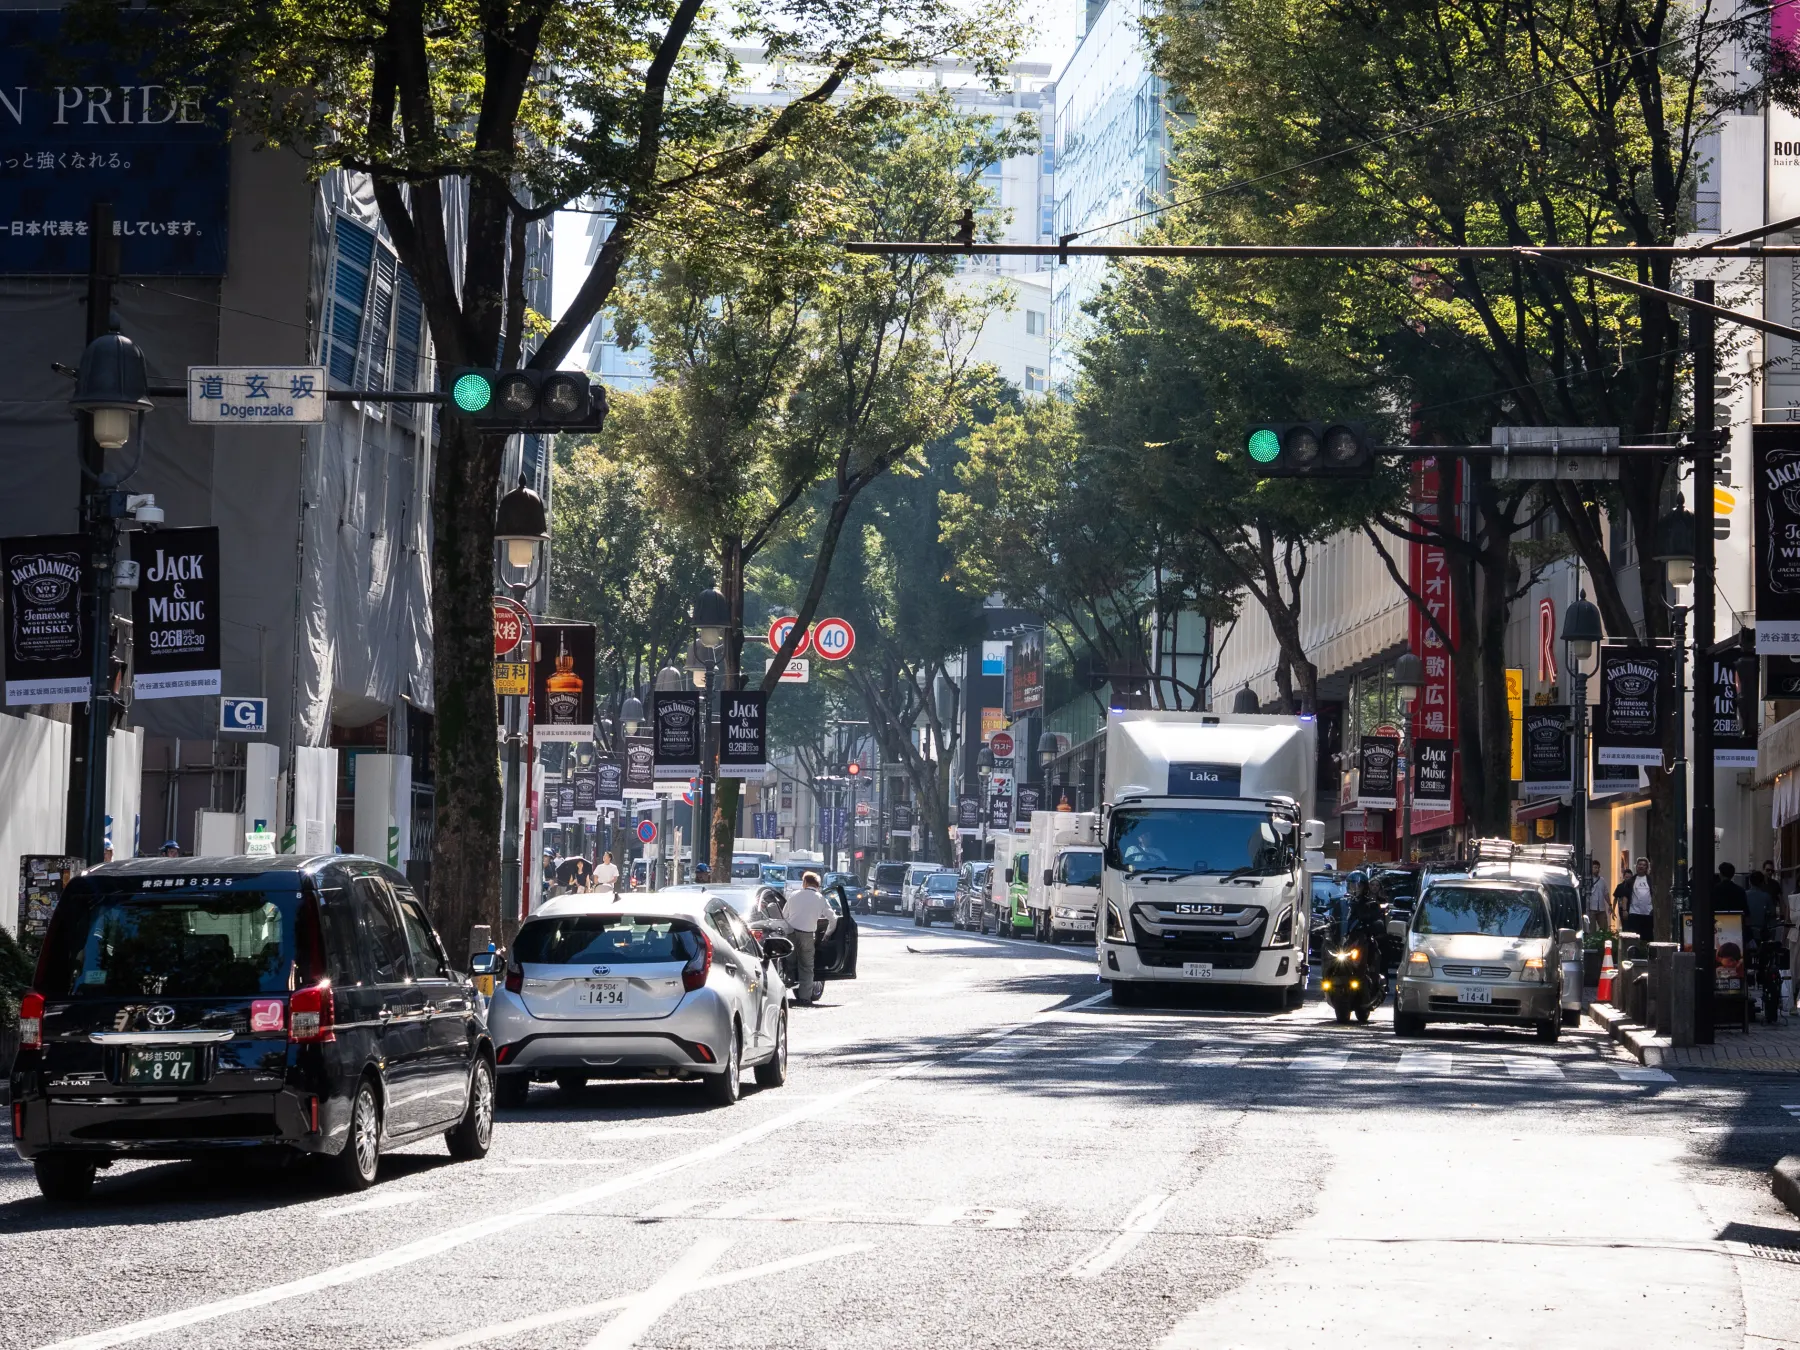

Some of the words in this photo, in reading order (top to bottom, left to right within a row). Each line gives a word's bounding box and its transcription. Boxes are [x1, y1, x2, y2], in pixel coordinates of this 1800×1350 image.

[53, 85, 205, 125] PRIDE
[0, 152, 131, 169] っと強くなれる。
[199, 374, 315, 399] 道玄坂
[220, 403, 294, 418] Dogenzaka
[11, 562, 38, 585] JACK
[38, 558, 82, 583] DANIEL'S
[147, 549, 204, 582] JACK
[173, 582, 186, 599] &
[24, 609, 70, 621] Tennessee
[148, 597, 205, 623] MUSIC
[21, 624, 74, 635] WHISKEY
[150, 630, 177, 648] 9.26
[183, 634, 205, 646] 23:30
[823, 630, 845, 647] 40
[495, 664, 526, 680] 歯科
[1607, 665, 1628, 681] JACK
[1627, 662, 1659, 681] DANIEL'S
[1425, 656, 1445, 734] 歌広場
[1724, 685, 1734, 698] &
[729, 700, 759, 718] JACK
[1615, 697, 1649, 707] Tennessee
[234, 701, 256, 725] G
[658, 704, 673, 717] JACK
[673, 702, 696, 716] DANIEL'S
[1612, 709, 1651, 717] WHISKEY
[741, 718, 749, 727] &
[1528, 721, 1542, 732] JACK
[729, 725, 759, 739] MUSIC
[1363, 748, 1376, 758] JACK
[1421, 746, 1447, 761] JACK
[1189, 771, 1219, 782] Laka
[1421, 766, 1446, 779] MUSIC
[142, 878, 185, 888] 東京無線
[189, 878, 233, 886] 8325
[1176, 904, 1223, 914] ISUZU
[1190, 969, 1211, 977] 41-25
[589, 991, 624, 1004] 14-94
[1466, 992, 1489, 1002] 14-41
[144, 1052, 163, 1062] 杉並
[164, 1051, 181, 1061] 500
